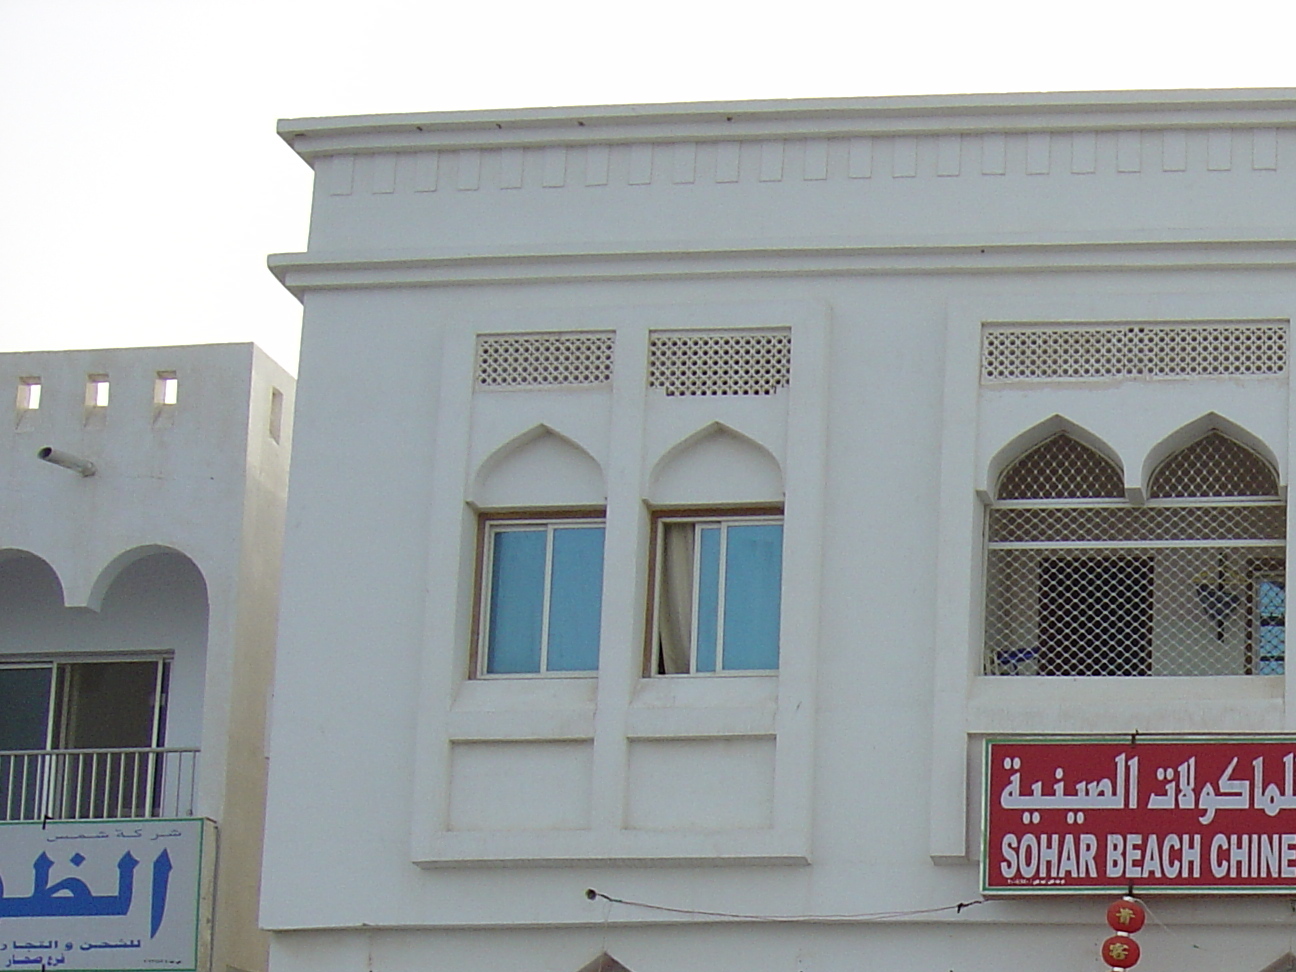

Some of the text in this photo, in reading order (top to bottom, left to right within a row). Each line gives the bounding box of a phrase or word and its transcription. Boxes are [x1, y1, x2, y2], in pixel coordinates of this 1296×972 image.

[1000, 752, 1139, 825] الصينية
[115, 828, 182, 841] شركة
[1000, 833, 1098, 879] SOHAR
[1106, 833, 1201, 879] BEACH
[0, 847, 173, 939] الظ
[0, 939, 59, 952] التجار
[63, 941, 74, 952] و
[5, 952, 66, 968] فرع صحار
